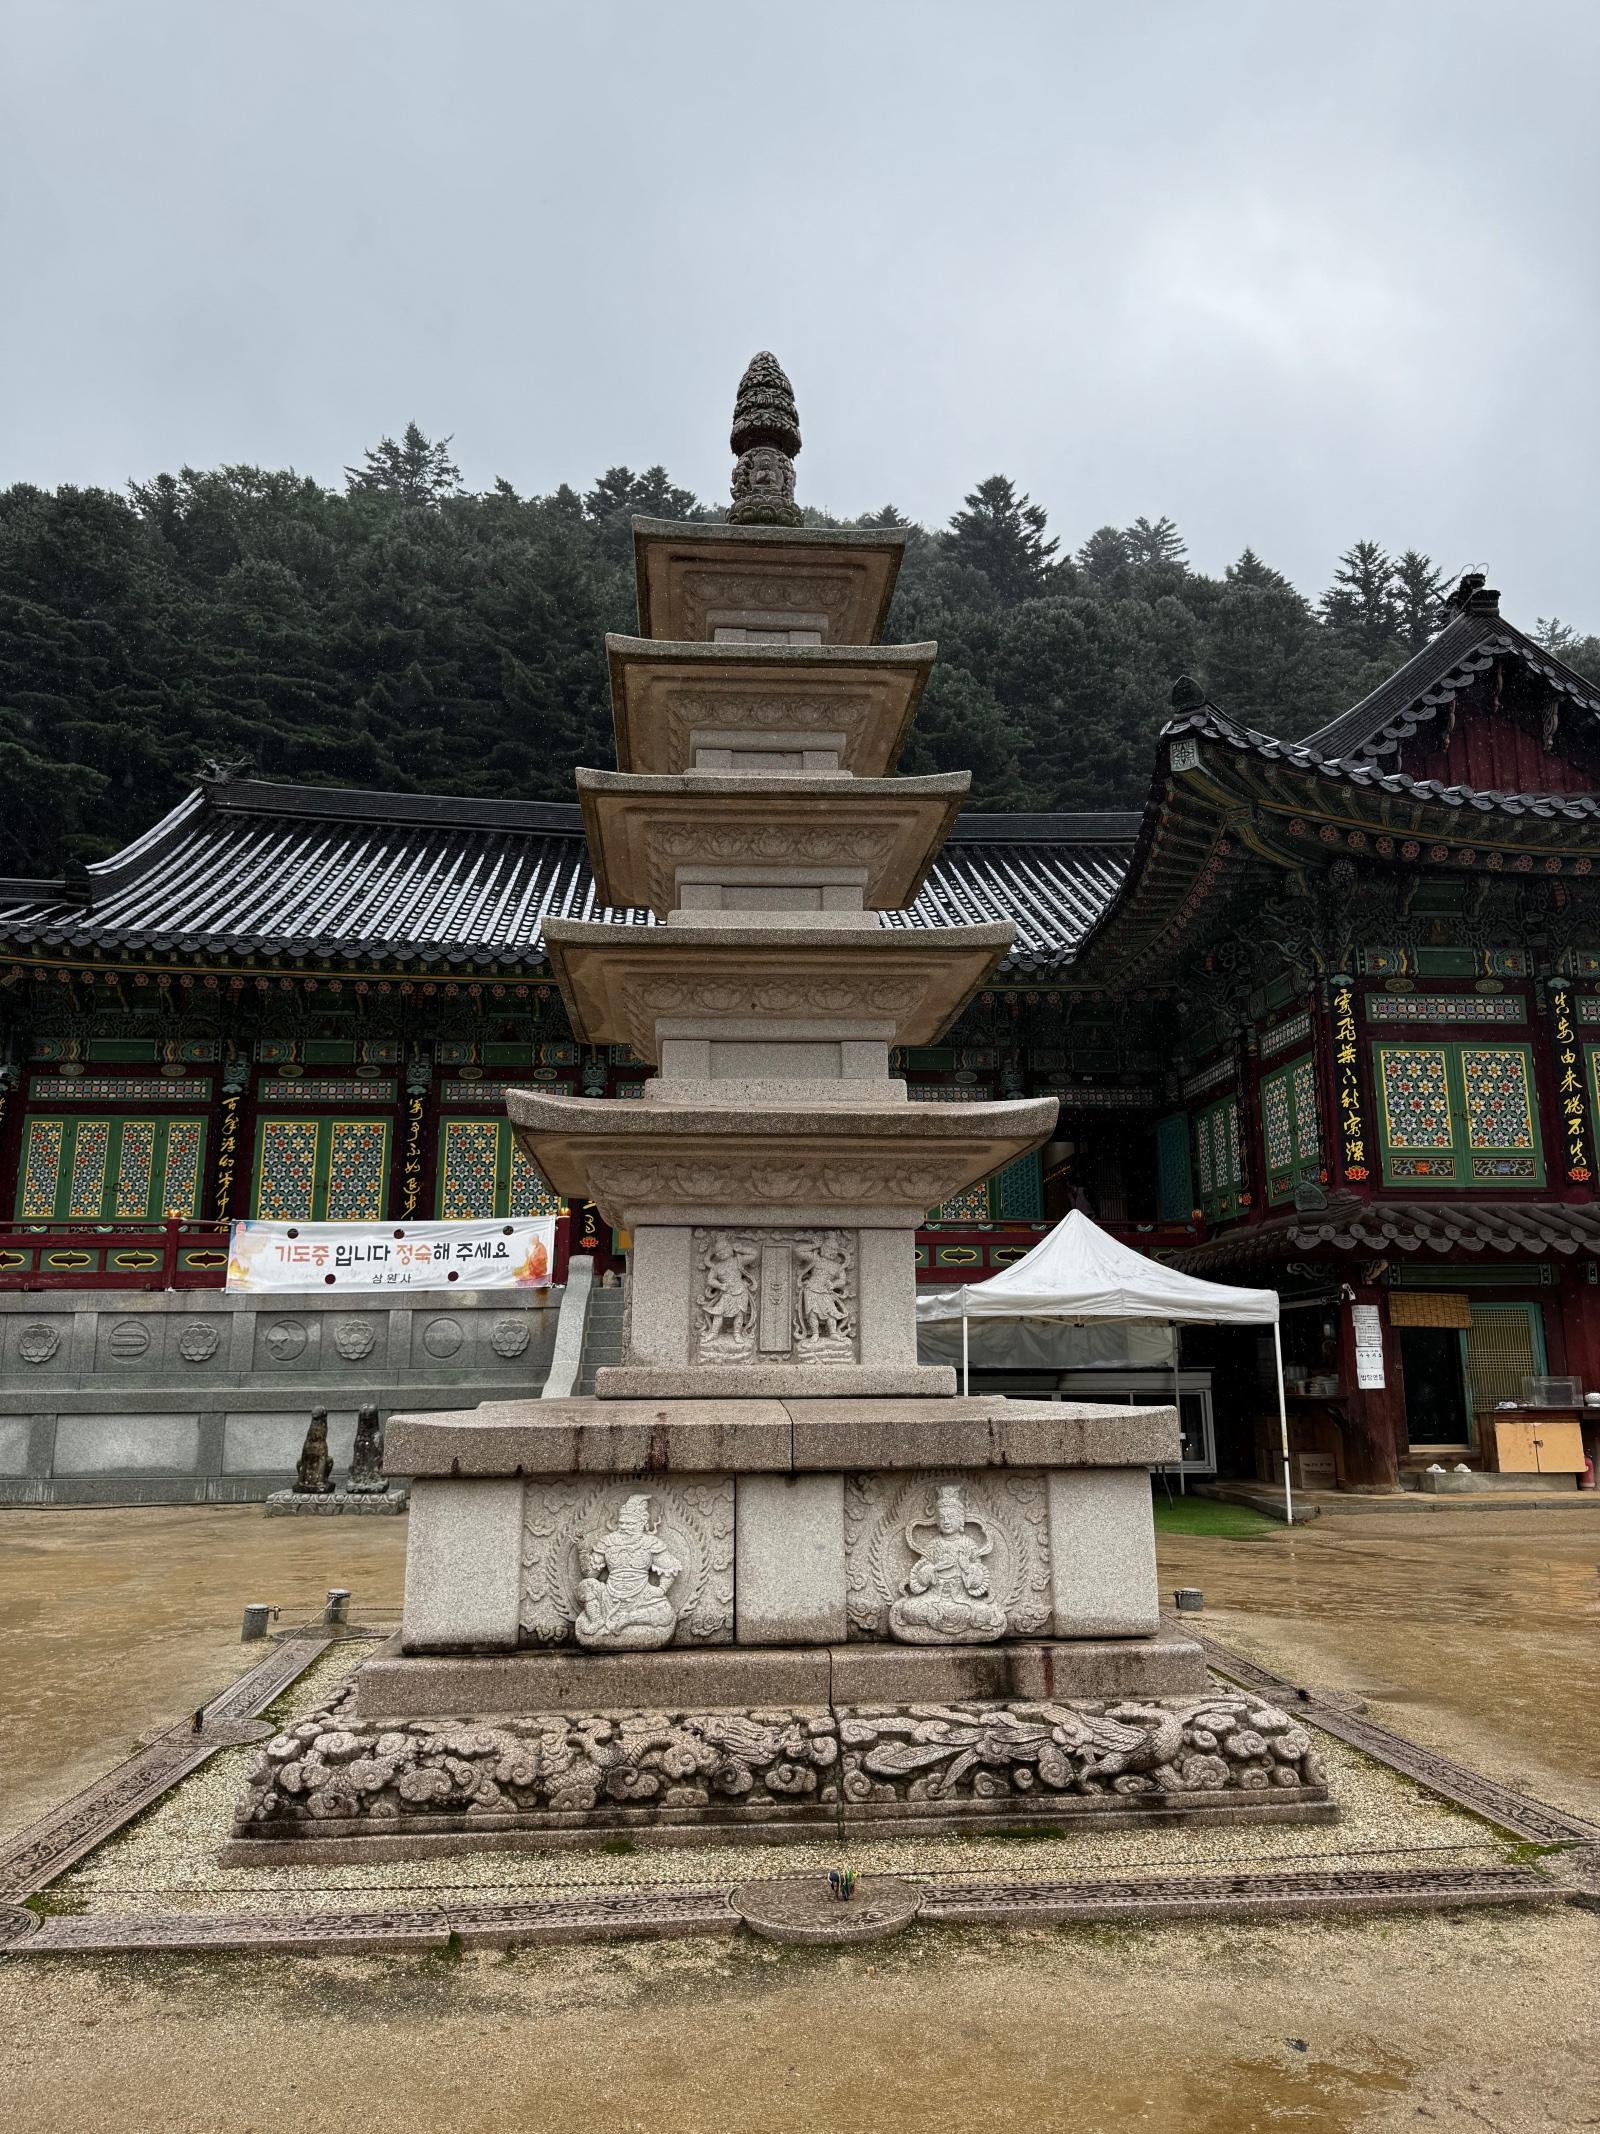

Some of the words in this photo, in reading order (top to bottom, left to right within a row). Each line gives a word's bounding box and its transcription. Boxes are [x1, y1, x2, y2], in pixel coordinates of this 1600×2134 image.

[275, 1245, 330, 1267] 기도중
[335, 1244, 391, 1267] 입니다
[396, 1243, 450, 1265] 정숙해
[456, 1241, 510, 1262] 주세요
[372, 1273, 411, 1284] 상원사
